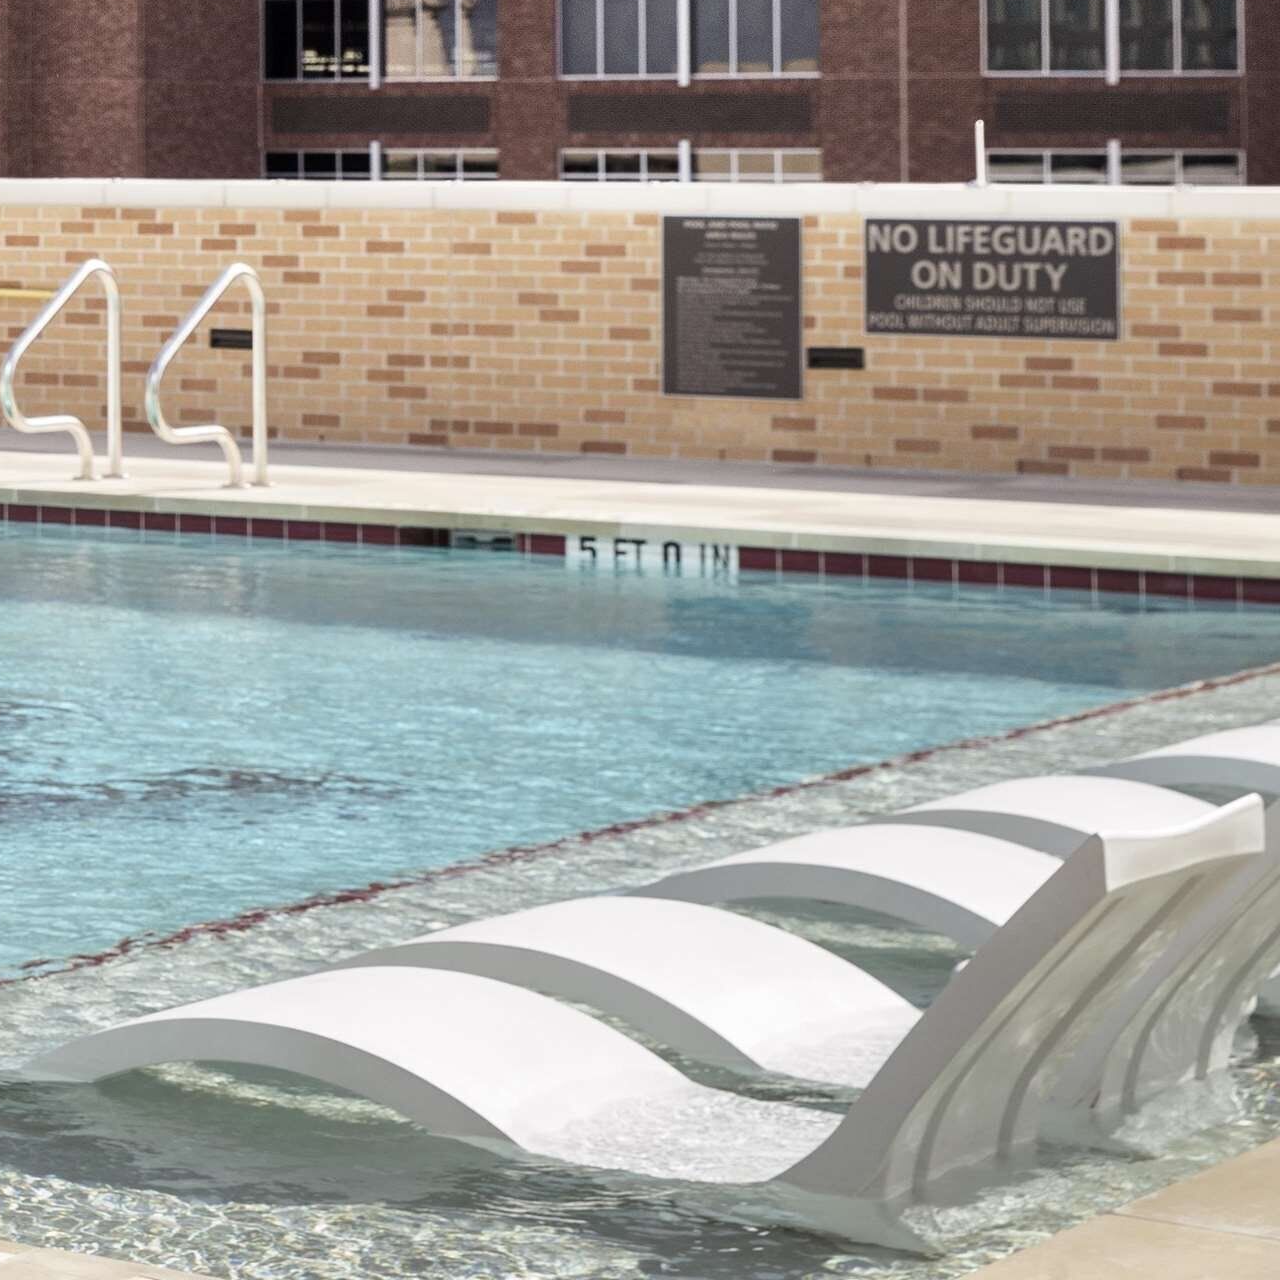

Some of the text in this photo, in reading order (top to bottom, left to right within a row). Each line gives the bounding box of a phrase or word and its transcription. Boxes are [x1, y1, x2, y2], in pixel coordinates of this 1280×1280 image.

[868, 224, 1114, 257] NO LIFEGUARD
[910, 260, 1068, 293] ON DUTY
[579, 536, 597, 563] 5
[614, 538, 647, 566] FT
[700, 543, 731, 571] IN
